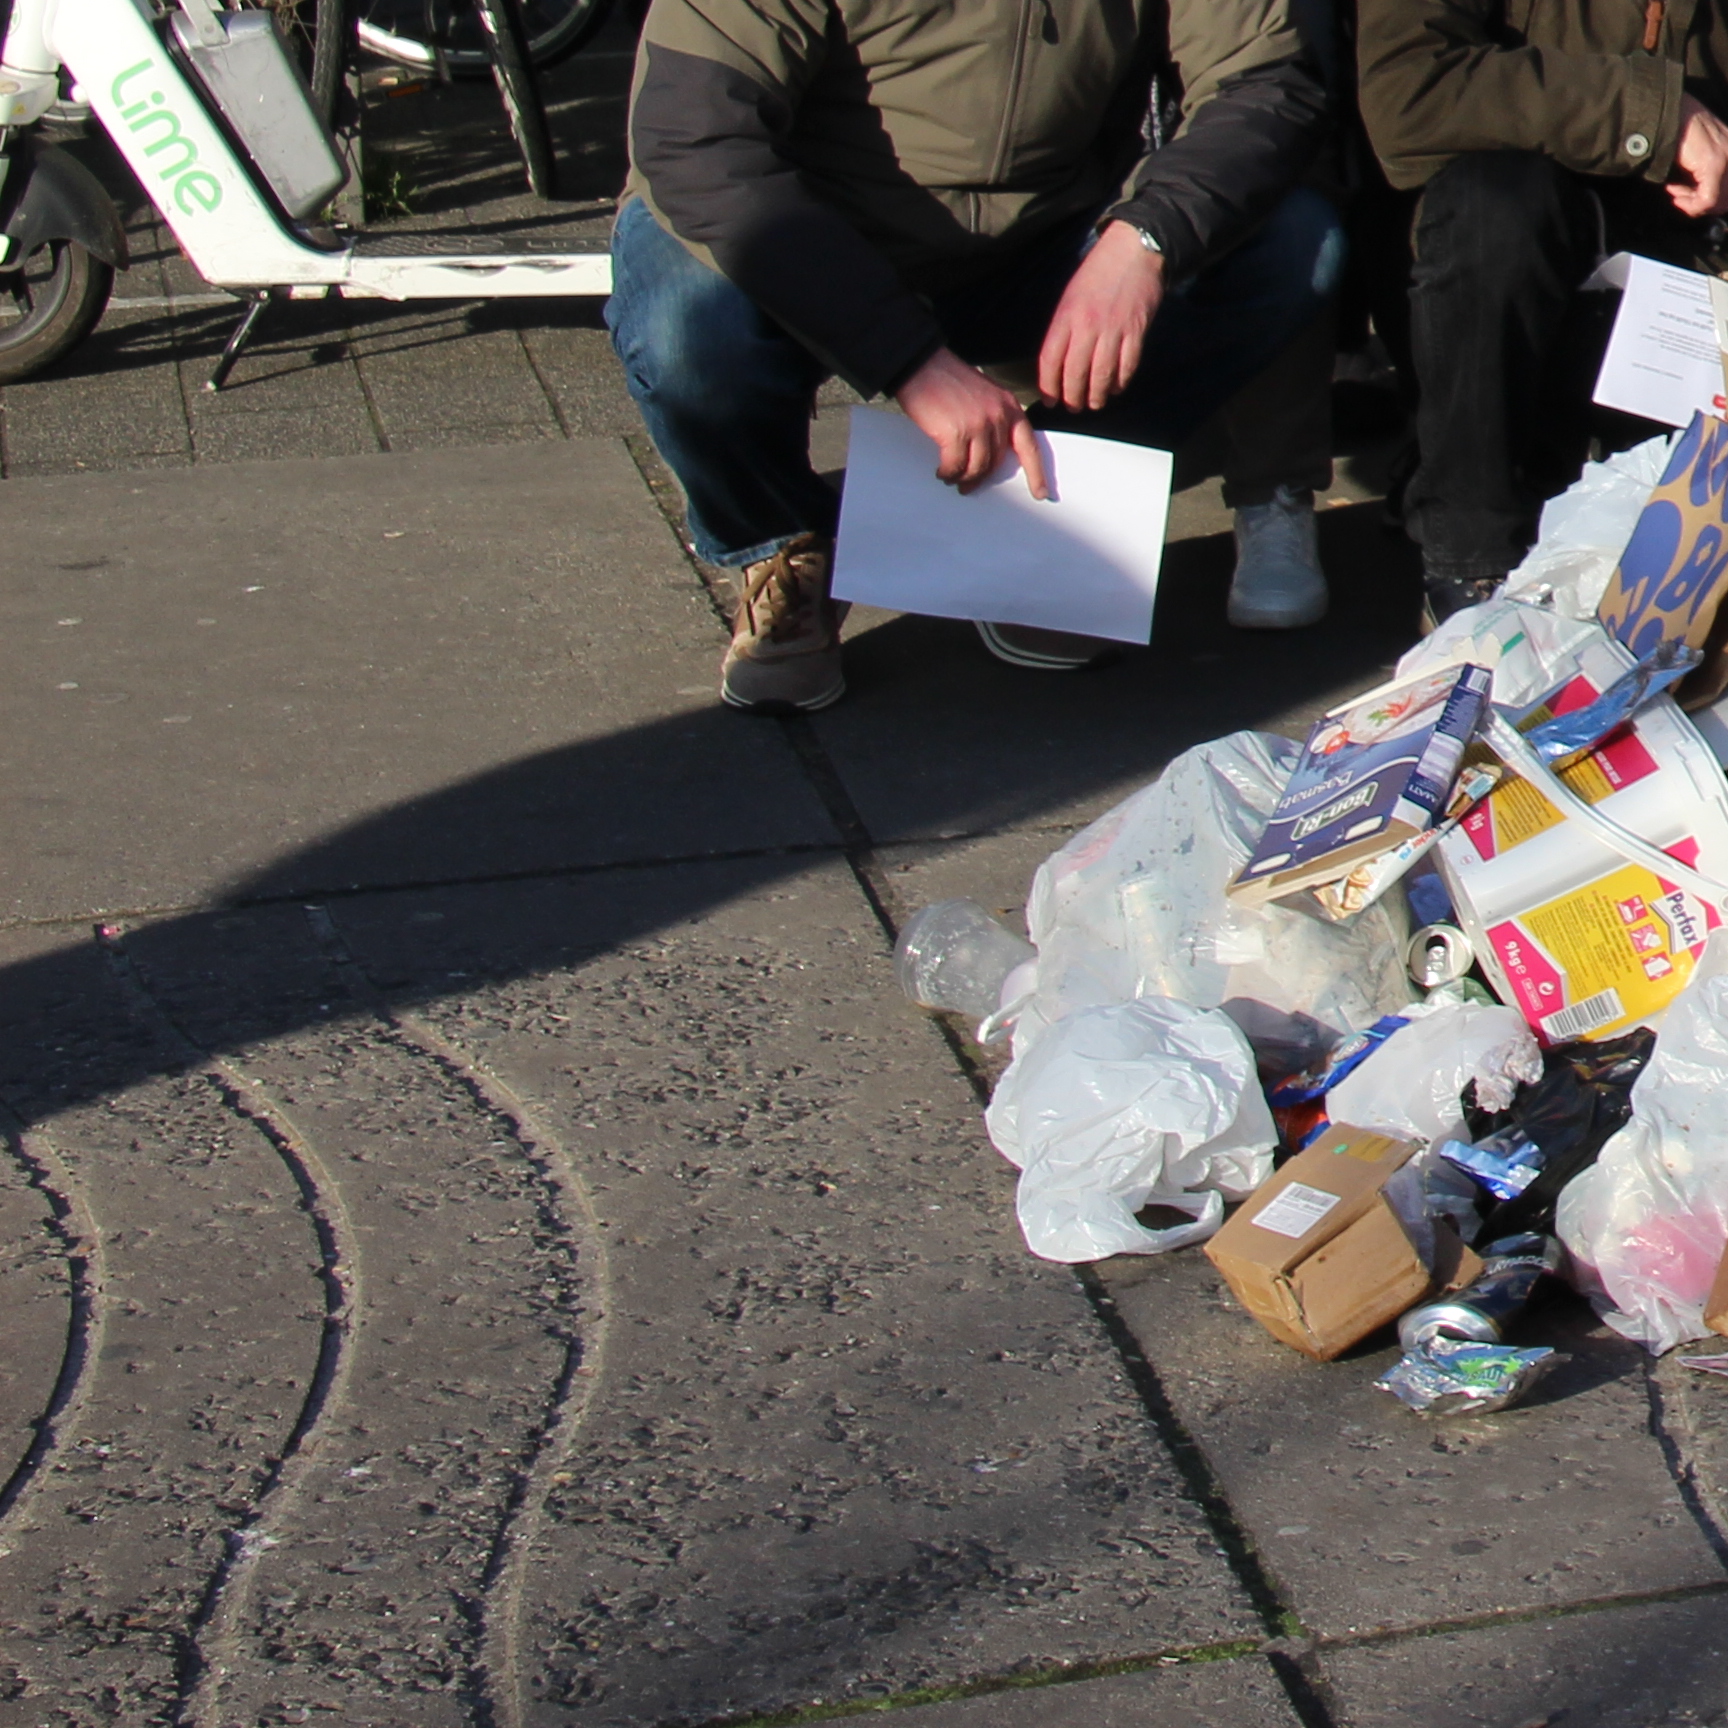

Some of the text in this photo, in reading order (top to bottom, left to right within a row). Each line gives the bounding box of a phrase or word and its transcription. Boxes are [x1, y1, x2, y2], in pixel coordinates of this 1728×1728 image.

[111, 58, 223, 217] Lime
[1665, 892, 1699, 945] Perfax
[1504, 940, 1522, 967] 9kg
